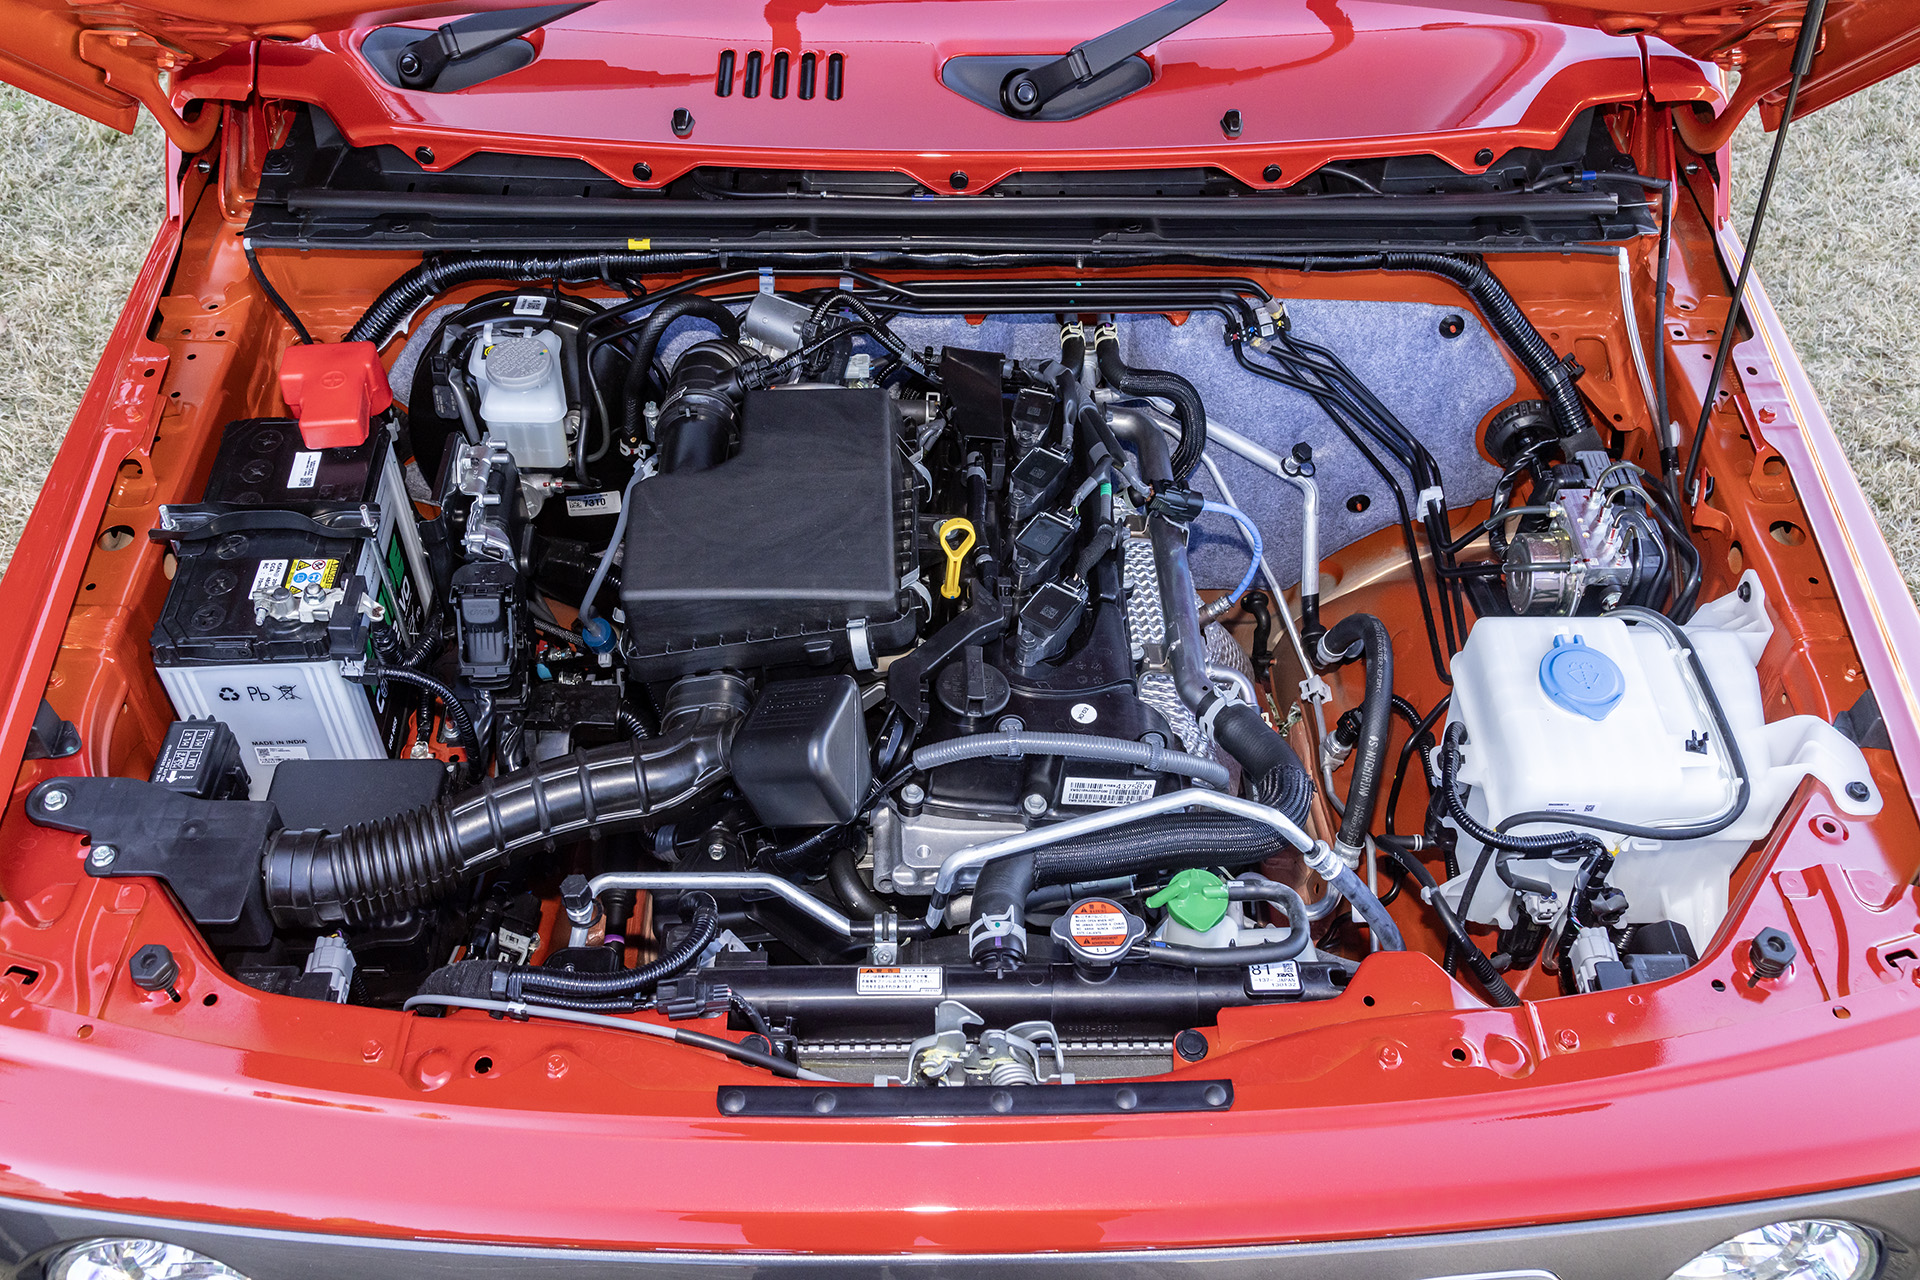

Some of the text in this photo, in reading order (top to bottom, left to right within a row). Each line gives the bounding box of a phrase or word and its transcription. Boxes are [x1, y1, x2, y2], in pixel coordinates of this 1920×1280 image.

[584, 498, 606, 507] 73T0
[246, 686, 270, 701] Pb
[1252, 964, 1270, 975] 81
